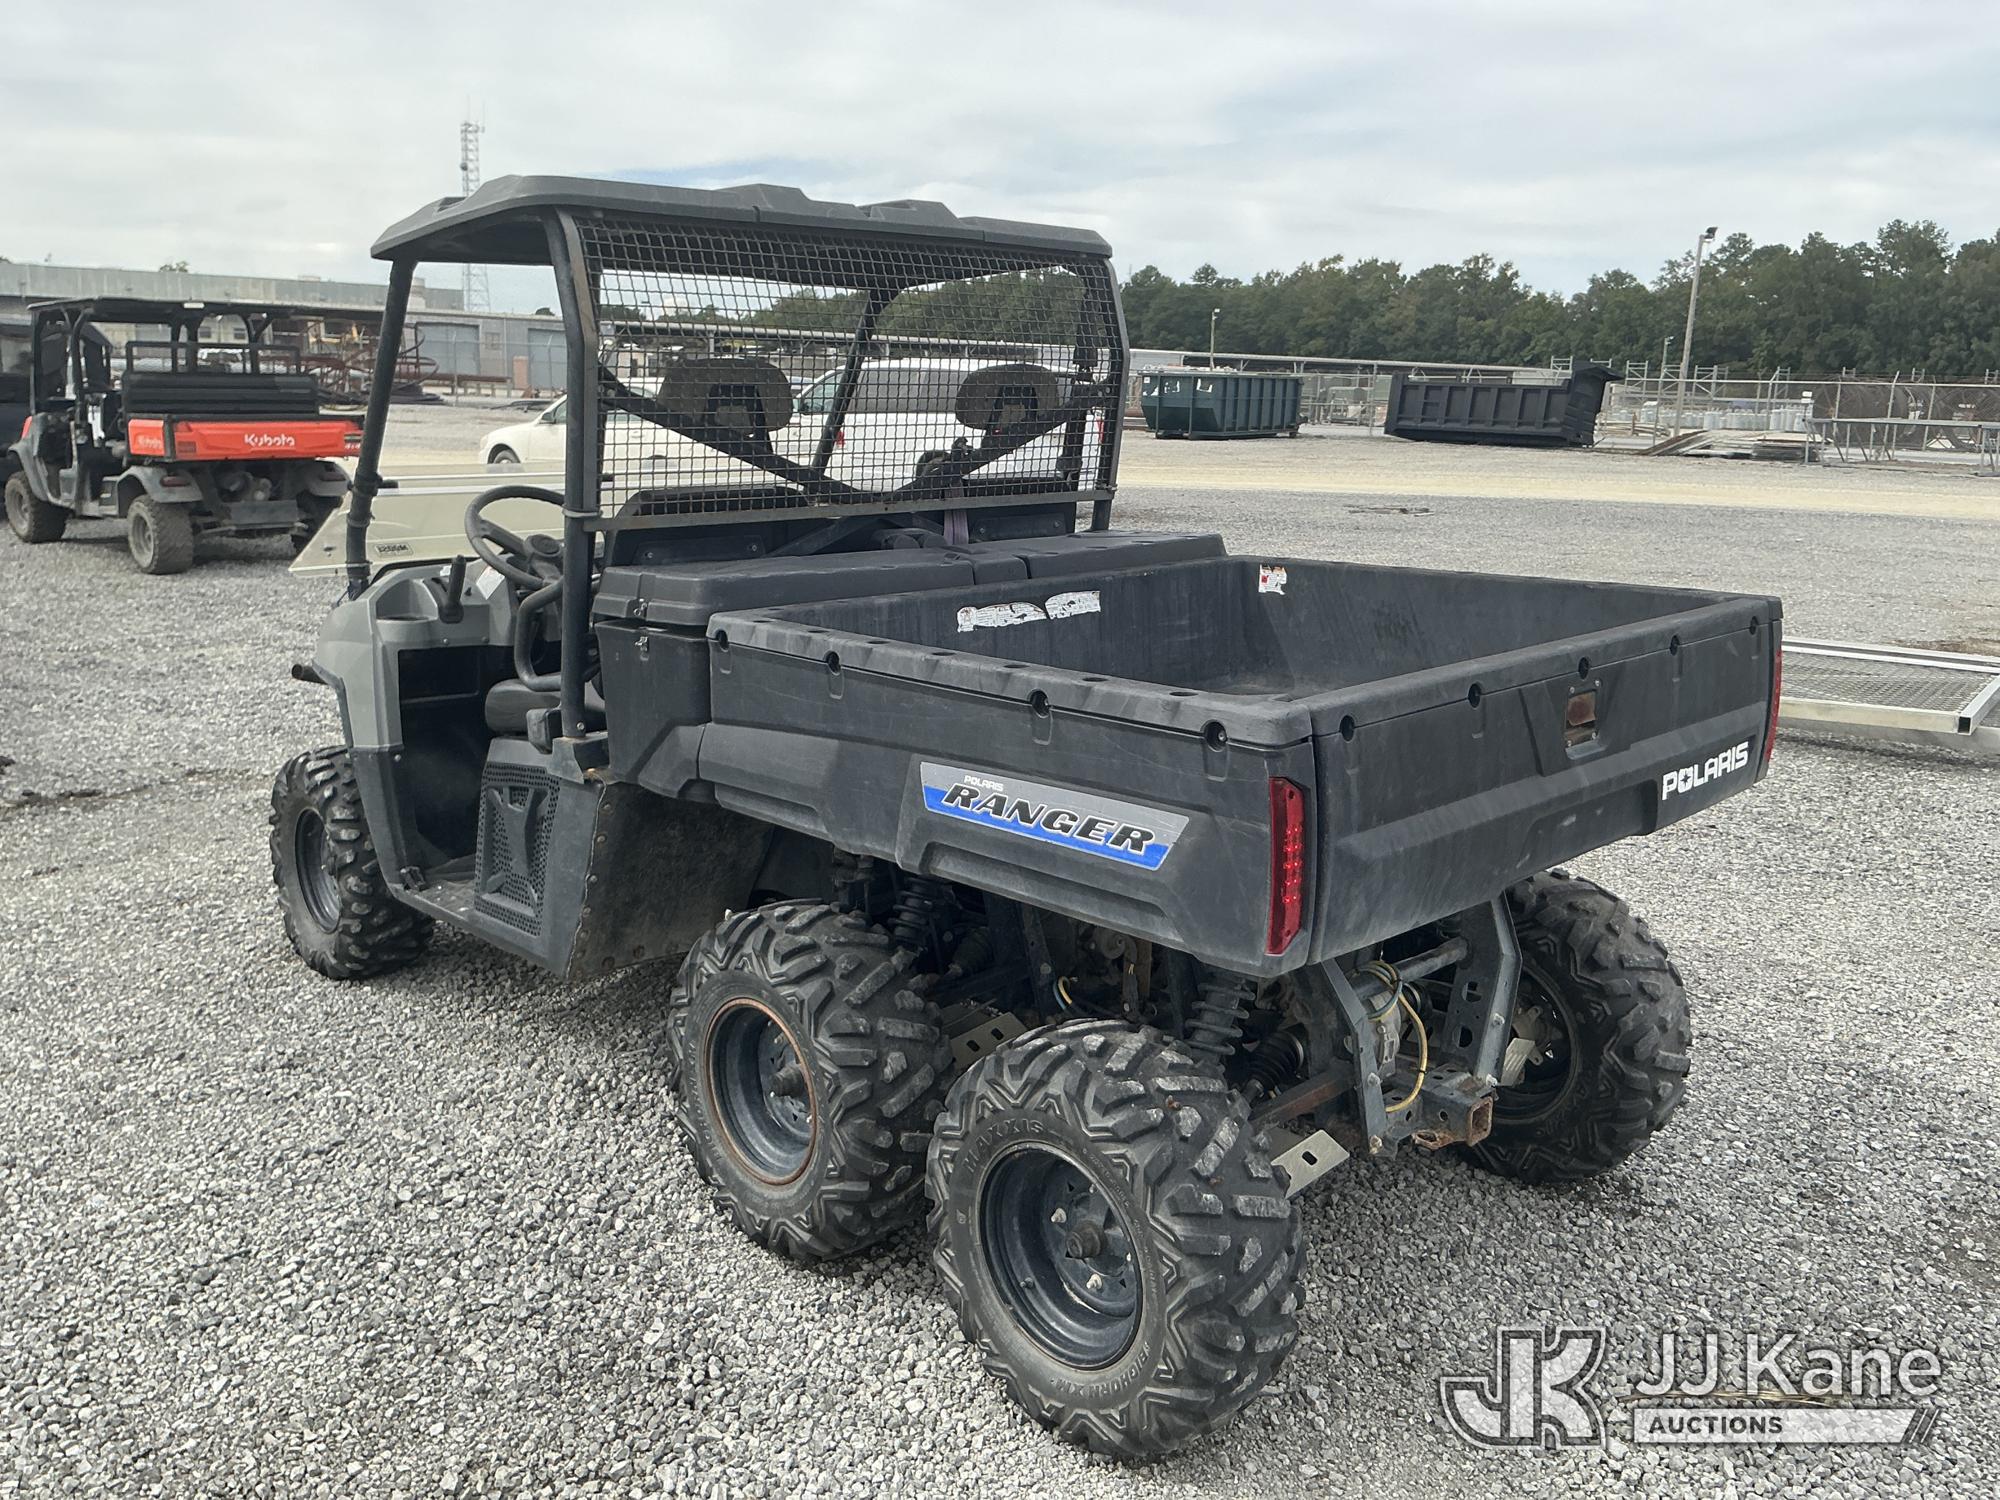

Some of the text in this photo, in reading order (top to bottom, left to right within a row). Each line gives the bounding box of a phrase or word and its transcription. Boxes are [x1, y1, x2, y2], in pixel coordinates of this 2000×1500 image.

[244, 433, 295, 447] Kubota
[963, 775, 1004, 792] POLARIS
[1662, 741, 1749, 800] POLARIS
[941, 783, 1155, 855] RANGER
